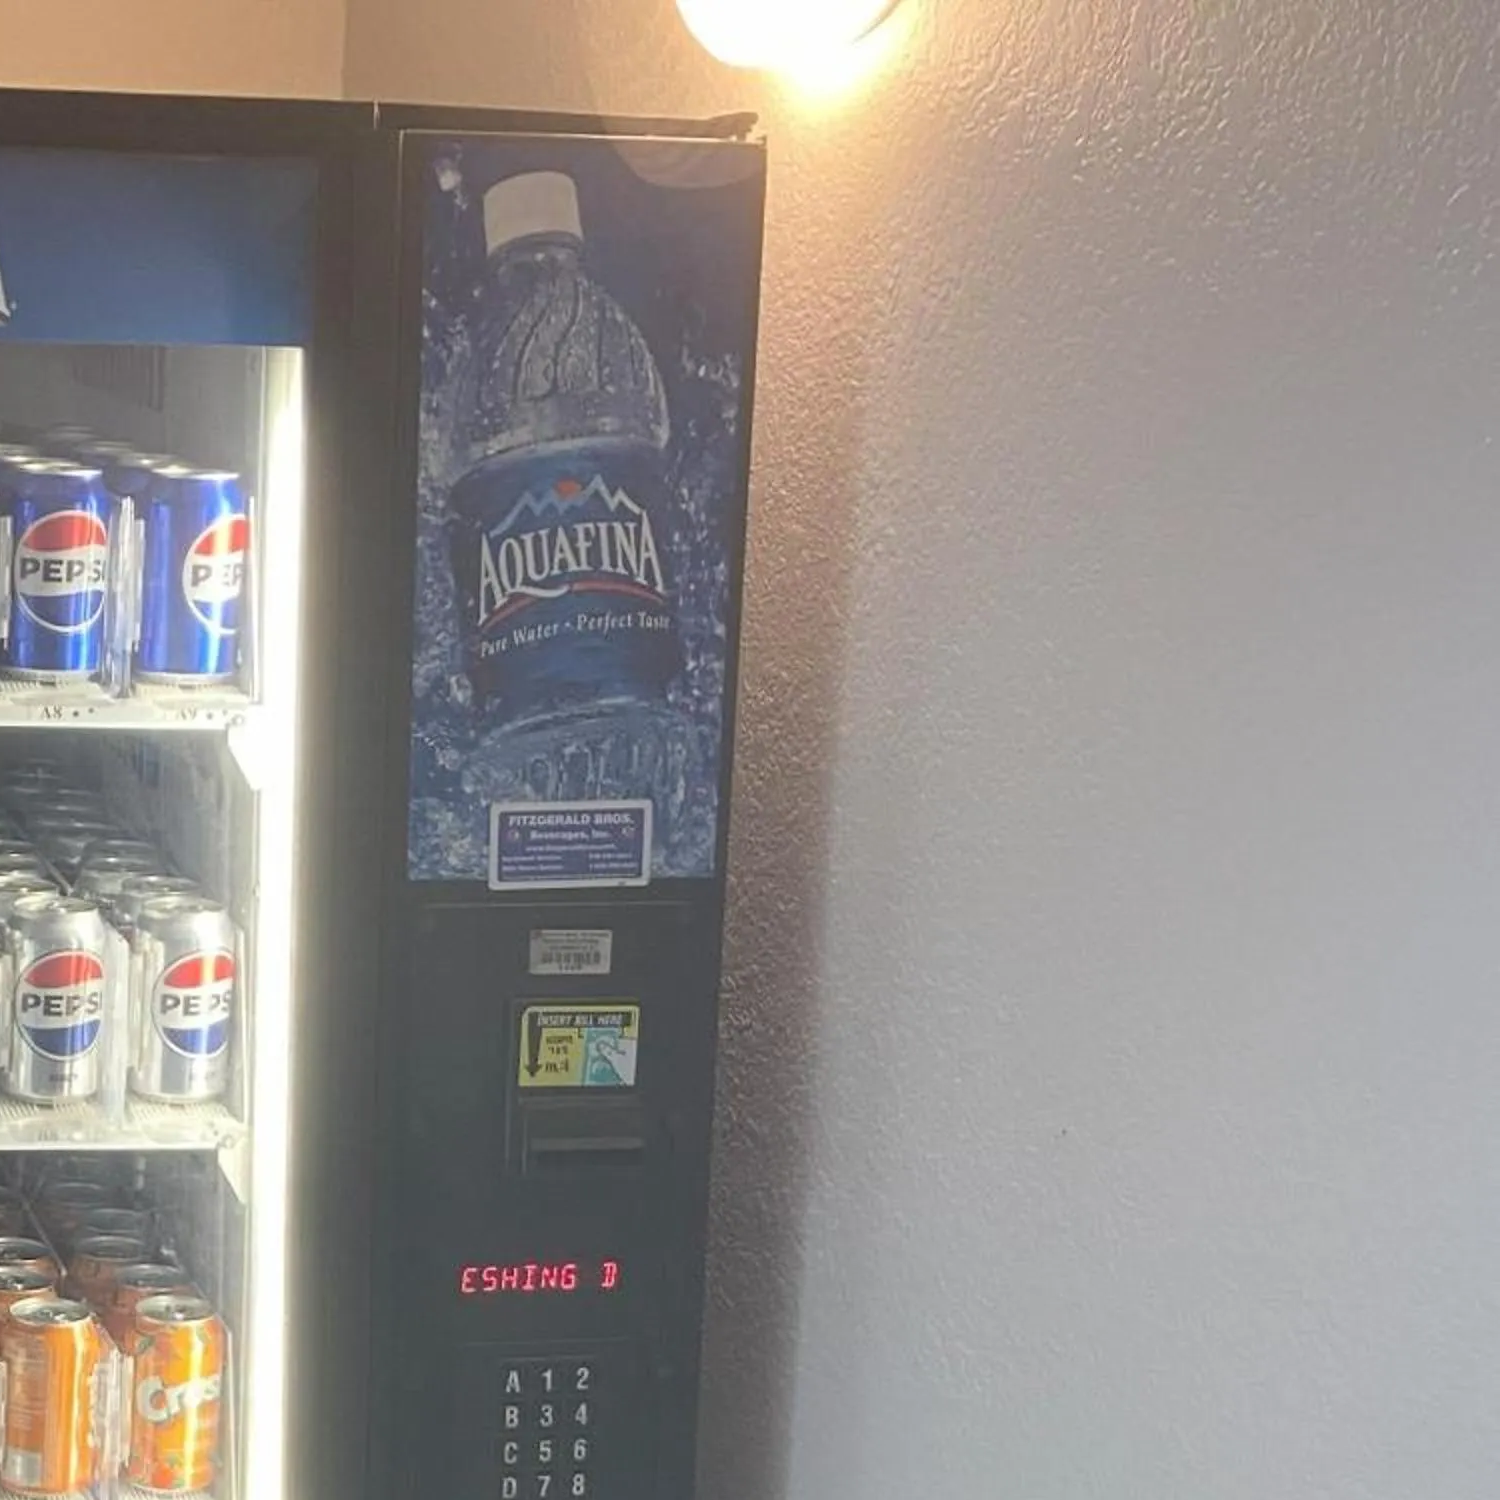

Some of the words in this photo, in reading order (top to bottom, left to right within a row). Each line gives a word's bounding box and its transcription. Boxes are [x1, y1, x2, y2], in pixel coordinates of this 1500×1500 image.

[19, 556, 107, 584] PEPS
[477, 510, 665, 627] AQUAFINA
[480, 638, 508, 657] Pure
[512, 623, 559, 645] Water
[577, 612, 633, 635] Perfect
[638, 611, 671, 630] Taste
[40, 705, 63, 719] A8
[508, 813, 591, 827] FITZGERALD
[461, 1263, 578, 1293] ESHING
[601, 1261, 619, 1289] D
[506, 1370, 521, 1392] A
[542, 1368, 553, 1391] 1
[576, 1367, 590, 1390] 2
[505, 1406, 519, 1428] B
[540, 1404, 553, 1427] 3
[575, 1403, 588, 1425] 4
[504, 1442, 518, 1464] C
[539, 1440, 552, 1462] 5
[574, 1439, 587, 1460] 6
[503, 1477, 517, 1499] D
[537, 1475, 551, 1497] 7
[572, 1474, 585, 1496] 8
